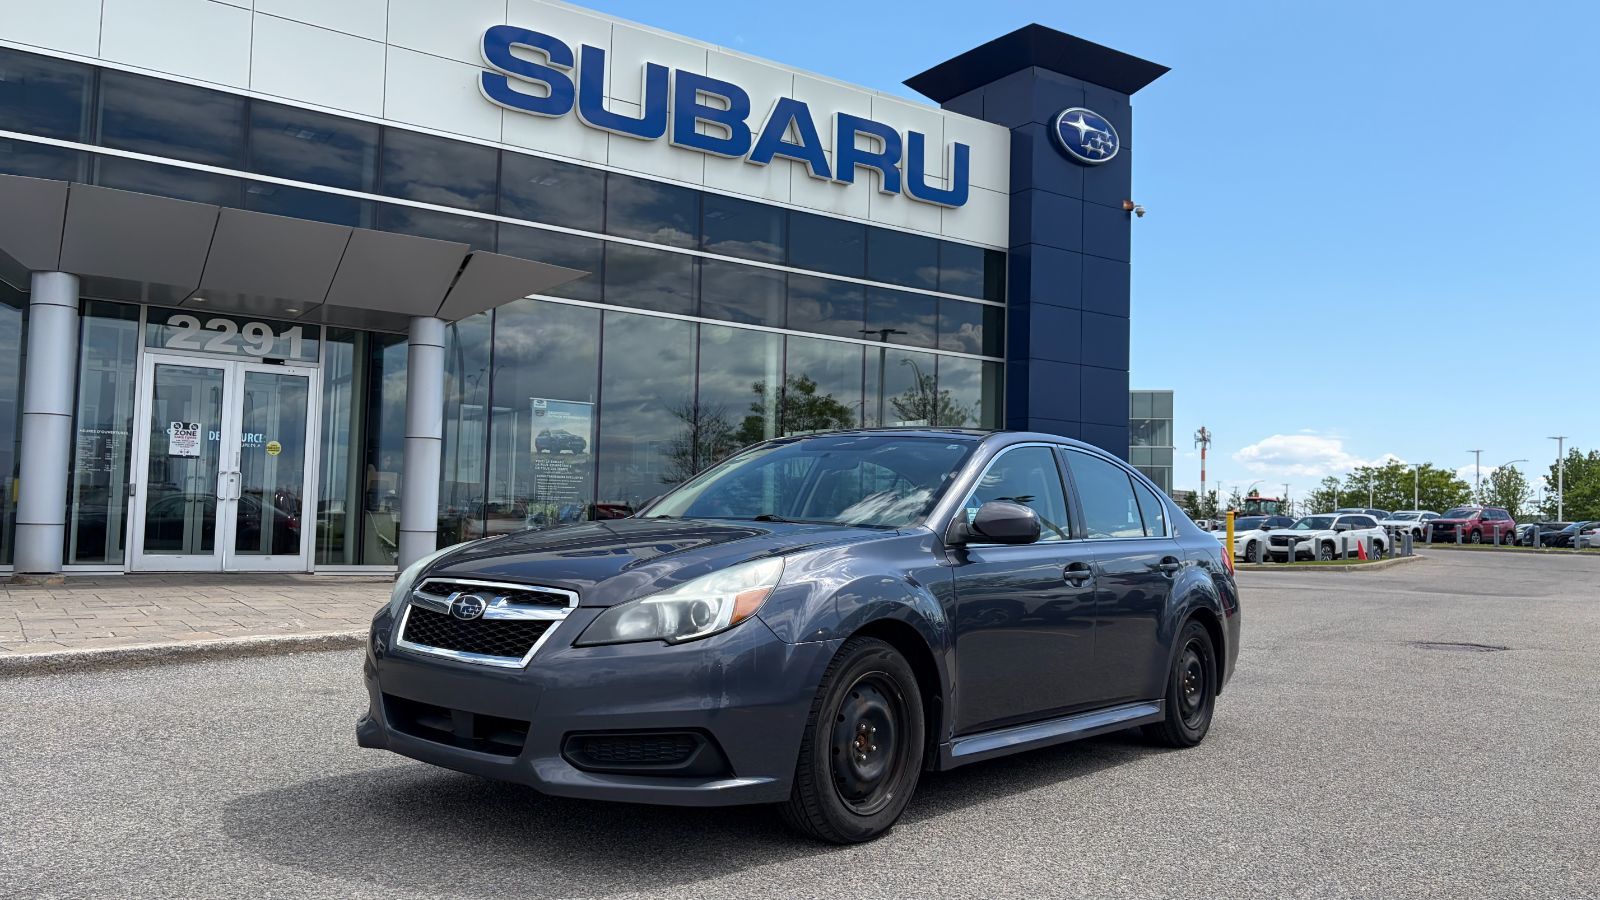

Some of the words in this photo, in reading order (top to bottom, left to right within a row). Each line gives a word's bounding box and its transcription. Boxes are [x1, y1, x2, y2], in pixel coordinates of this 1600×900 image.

[478, 24, 970, 209] SUBARU
[165, 314, 303, 359] 2291
[174, 429, 197, 437] ZONE
